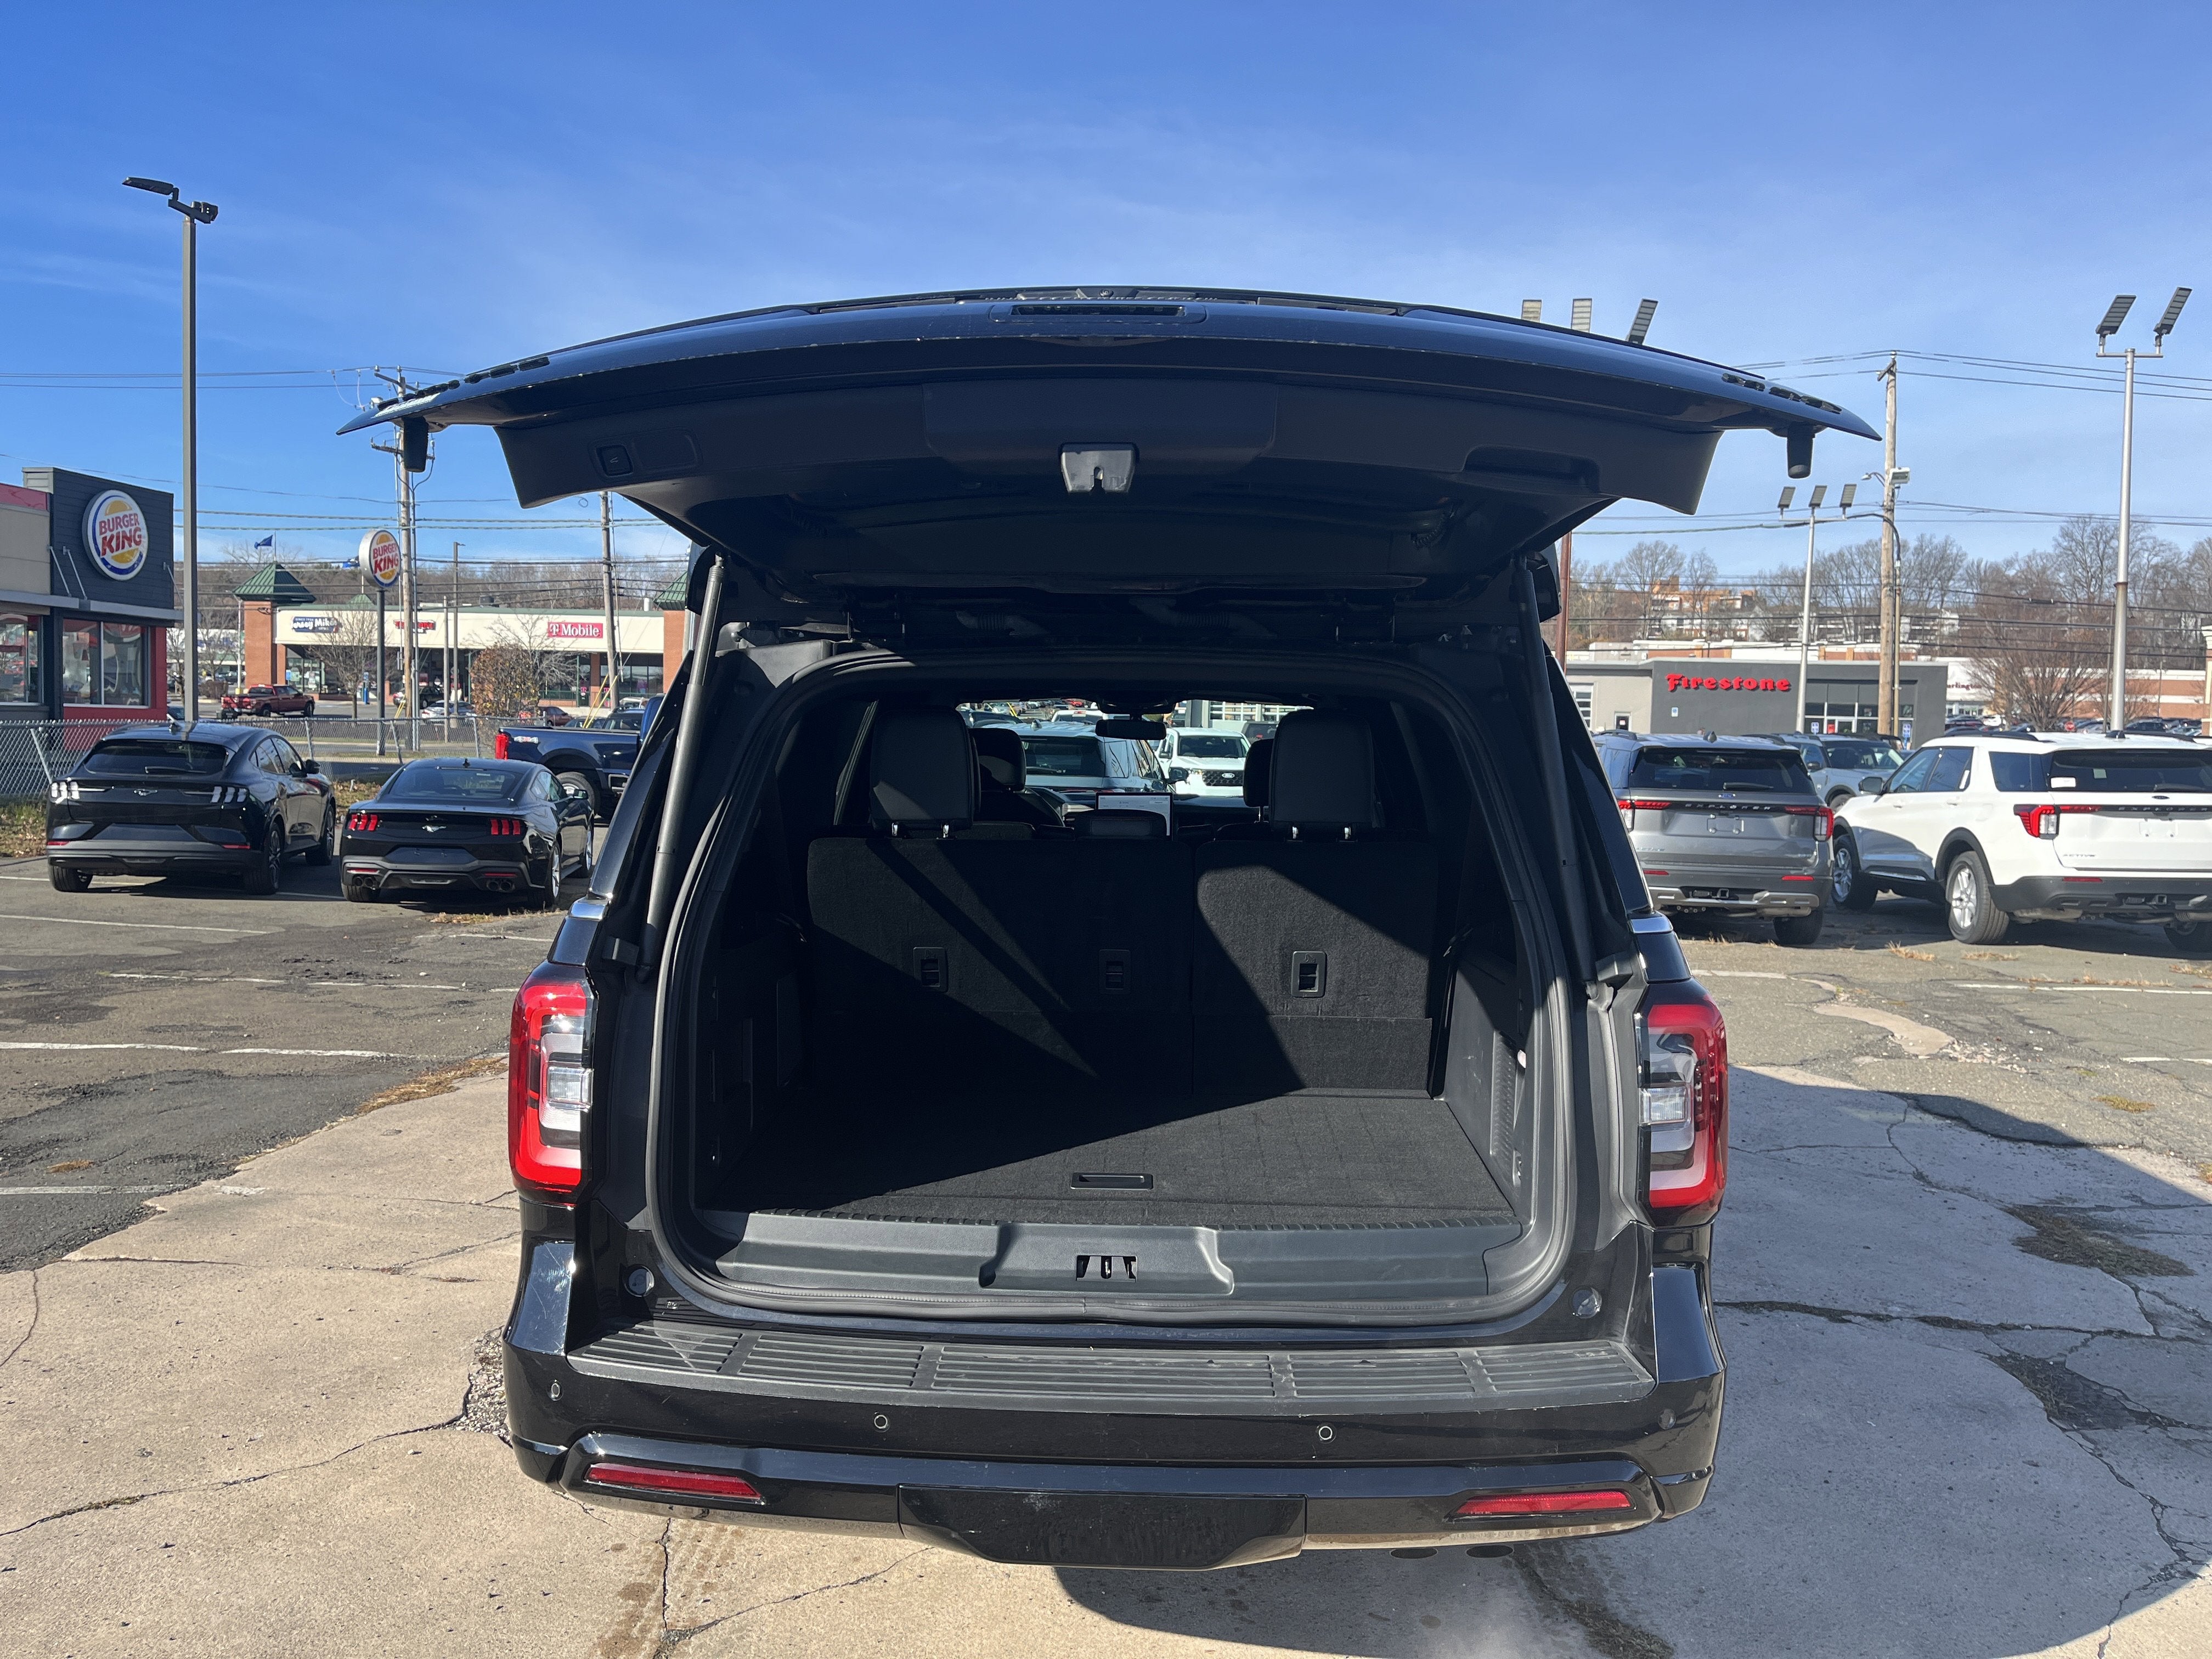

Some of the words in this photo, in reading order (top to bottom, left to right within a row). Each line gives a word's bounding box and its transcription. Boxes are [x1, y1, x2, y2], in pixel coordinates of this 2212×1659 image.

[99, 513, 139, 535] BURGER
[101, 527, 142, 556] KING
[373, 543, 398, 560] BURGER
[374, 554, 399, 574] KING
[293, 622, 313, 630] ersey
[314, 618, 337, 627] Mike
[561, 624, 600, 636] Mobile
[1665, 673, 1790, 691] Firestone
[1946, 682, 1982, 691] urlington
